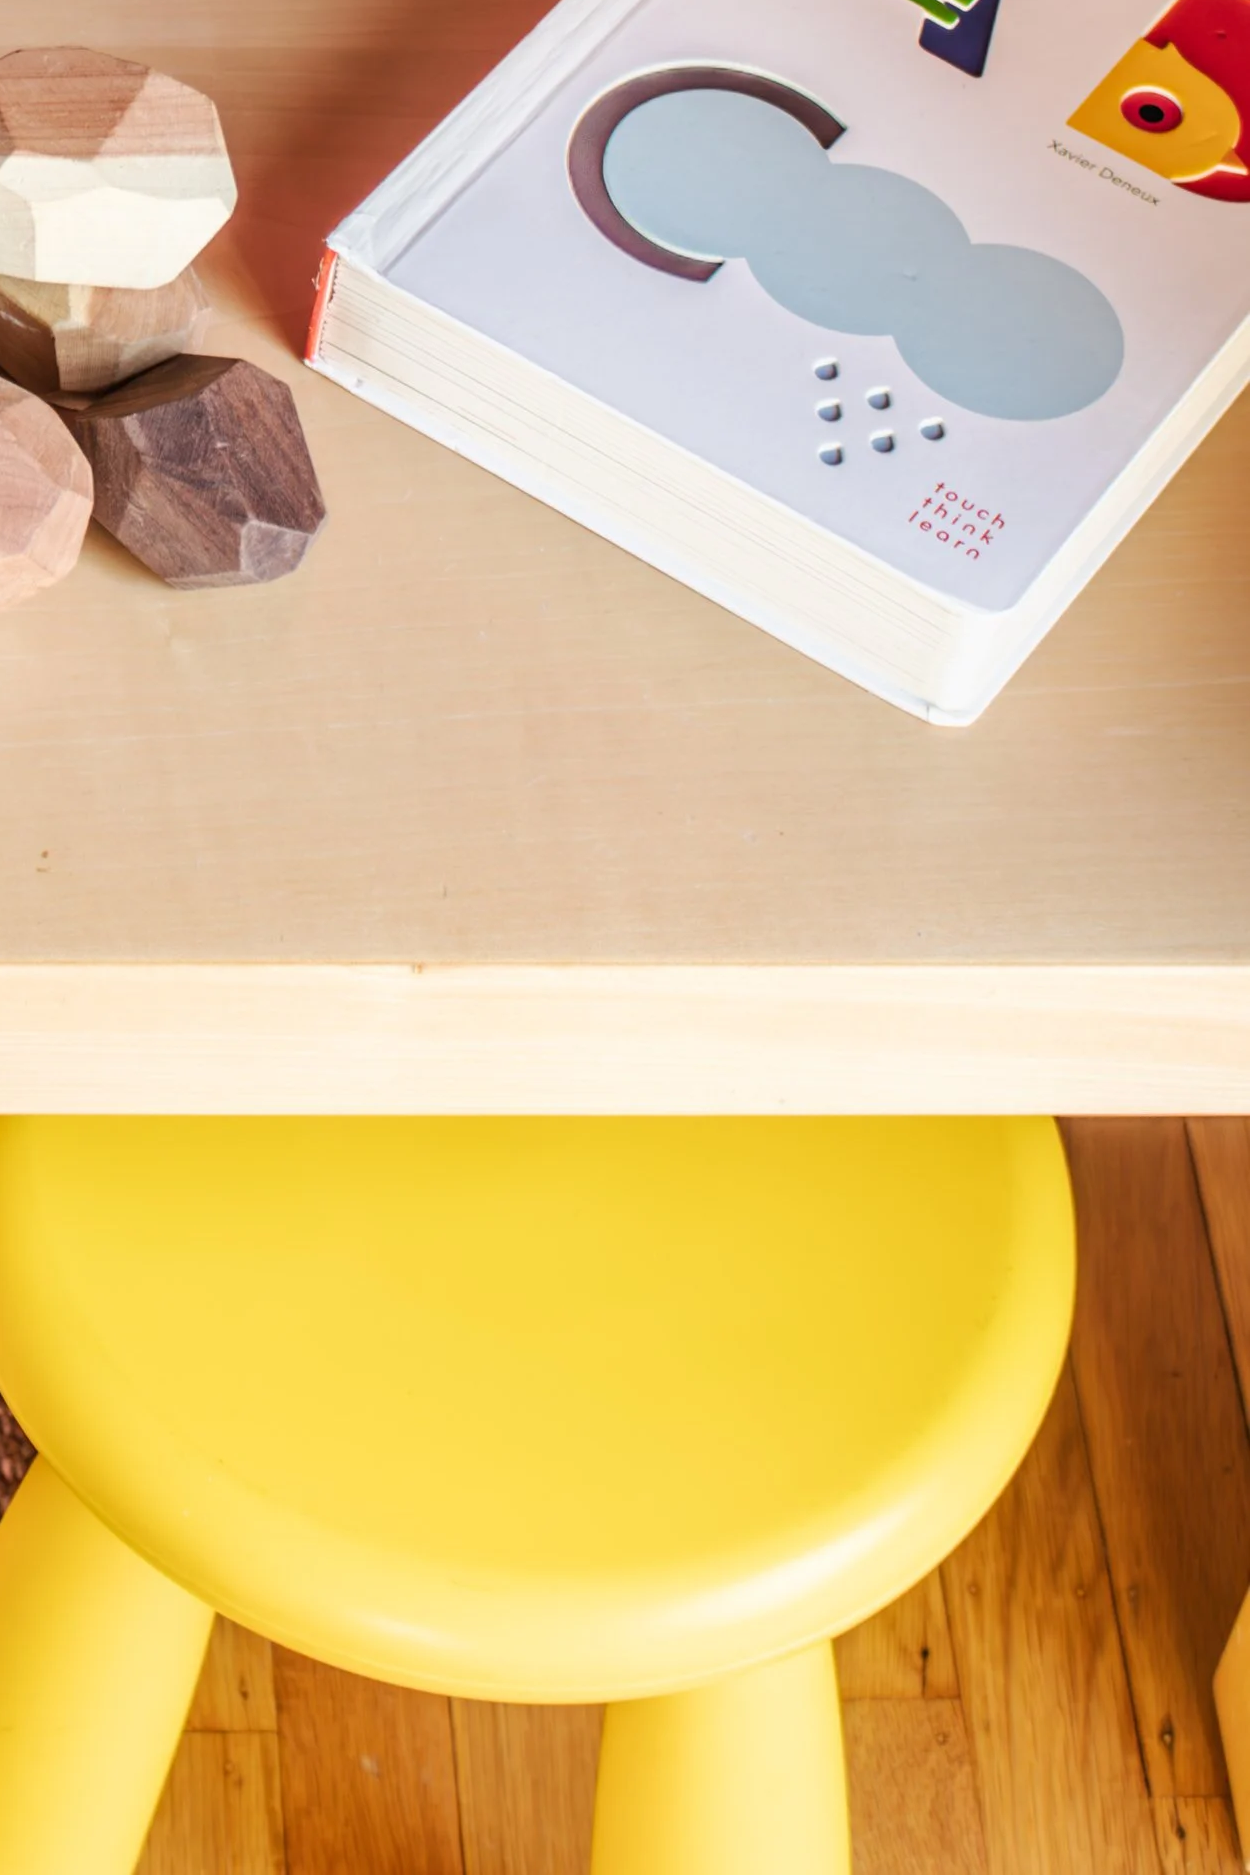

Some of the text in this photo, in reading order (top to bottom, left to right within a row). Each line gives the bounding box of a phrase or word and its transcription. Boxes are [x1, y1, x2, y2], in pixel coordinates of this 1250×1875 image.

[1047, 139, 1161, 206] Xavier Deneux
[922, 497, 994, 545] think
[934, 482, 1005, 529] touch
[908, 511, 980, 560] learn
